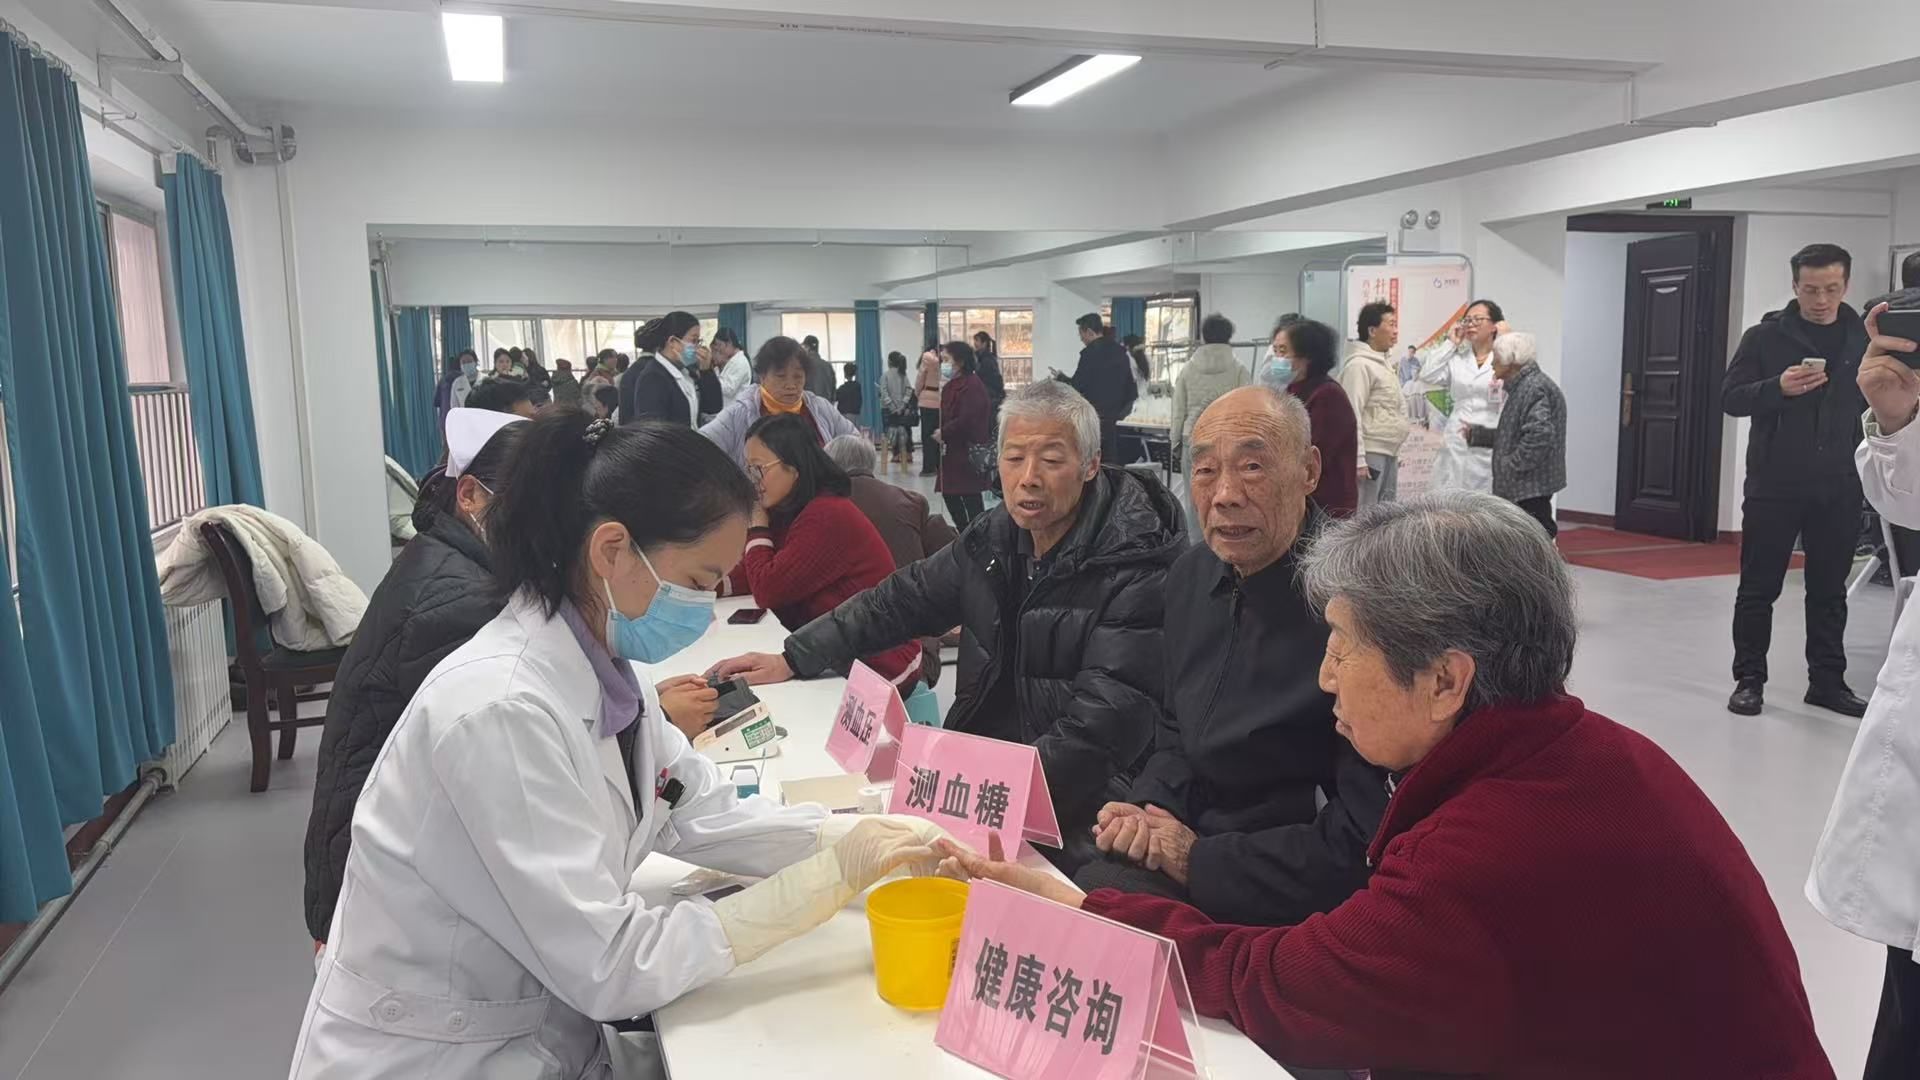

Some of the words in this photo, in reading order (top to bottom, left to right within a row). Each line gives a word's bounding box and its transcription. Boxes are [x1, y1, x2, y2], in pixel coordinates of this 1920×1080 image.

[840, 695, 876, 746] 测血压
[905, 766, 1010, 829] 测血糖
[971, 937, 1124, 1056] 健康咨询
